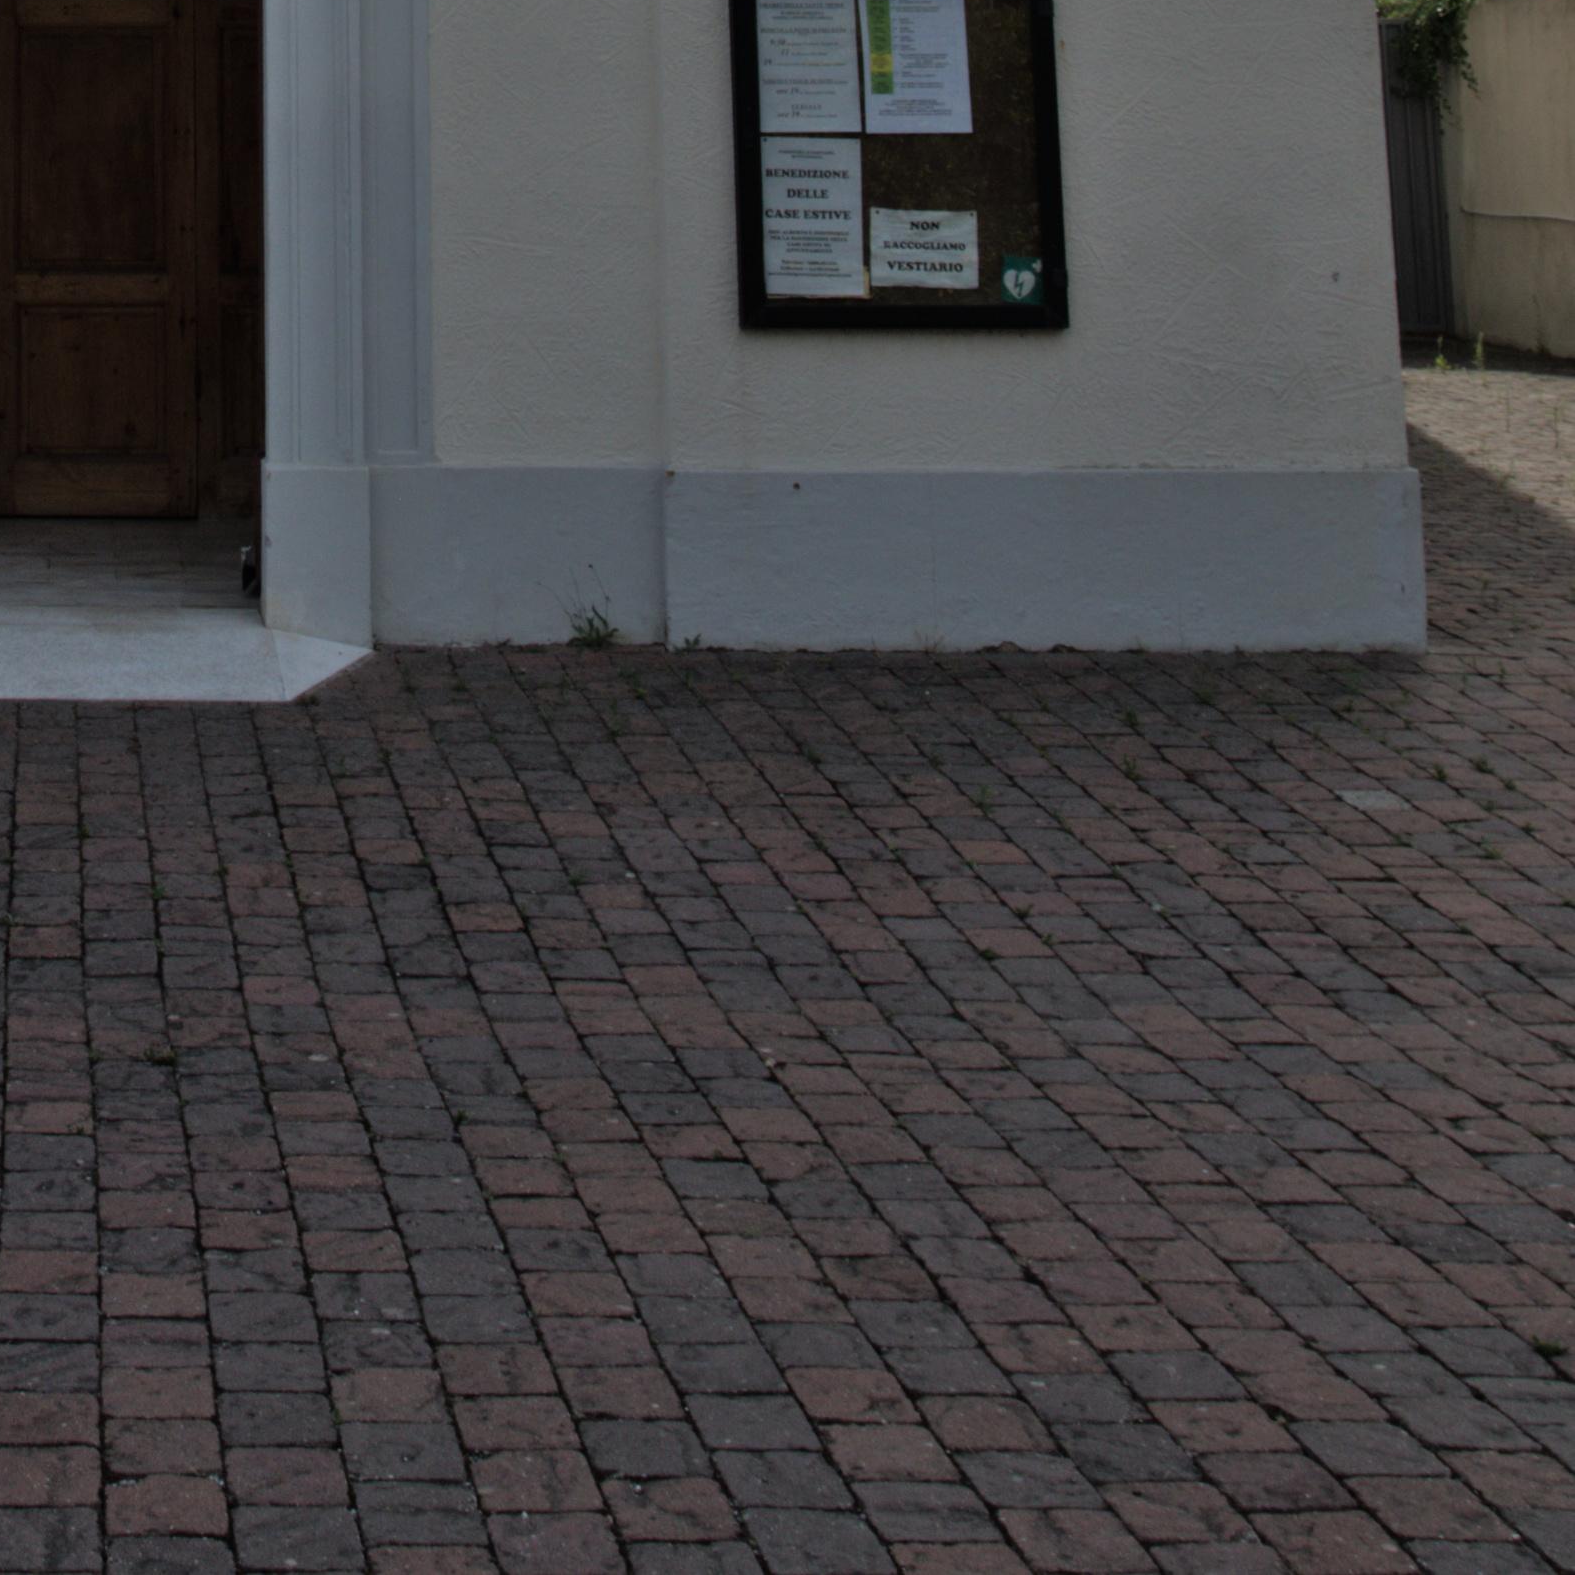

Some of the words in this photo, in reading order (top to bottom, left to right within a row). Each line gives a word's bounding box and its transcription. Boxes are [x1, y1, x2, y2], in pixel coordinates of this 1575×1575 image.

[765, 168, 850, 179] BENEDIZIONE
[786, 188, 829, 199] DELLE
[765, 208, 801, 219] CASE
[803, 209, 852, 220] ESTIVE
[909, 220, 940, 231] NON
[882, 240, 967, 251] RACCOGLIAMO
[886, 260, 964, 273] VESTIARIO
